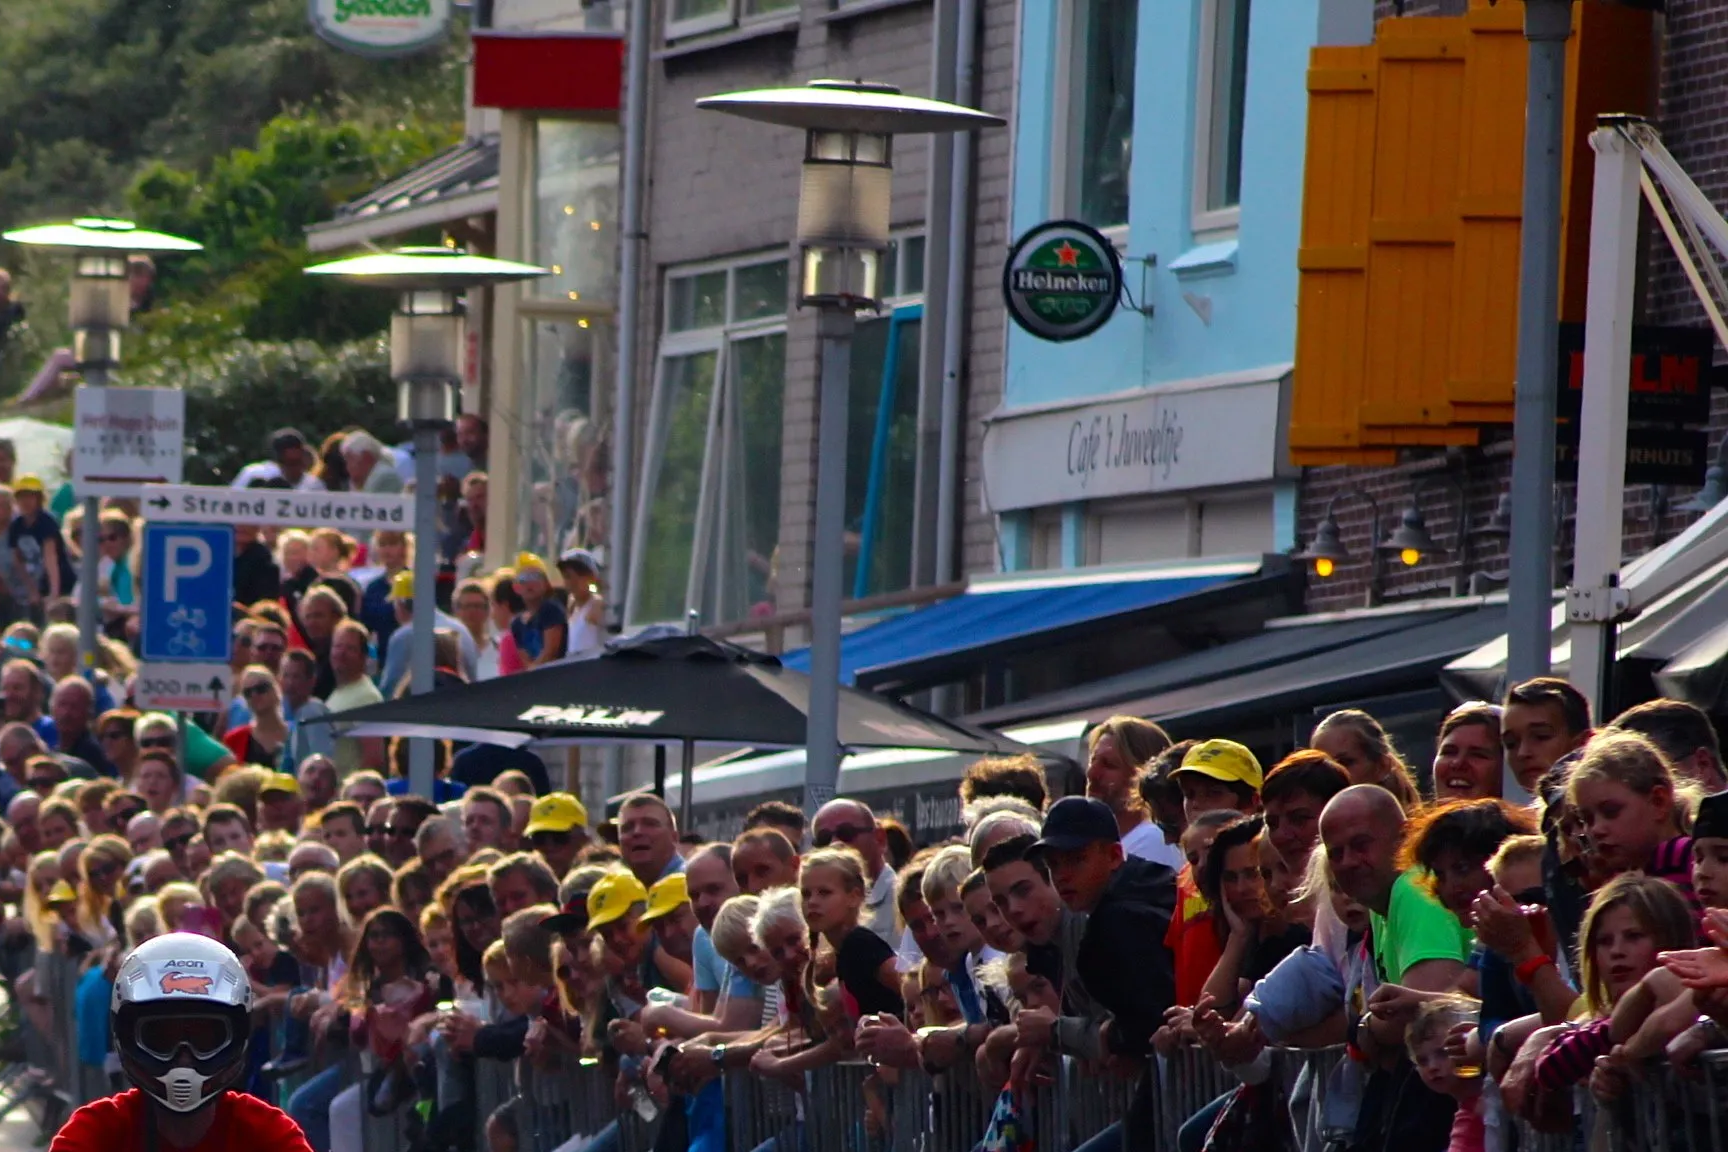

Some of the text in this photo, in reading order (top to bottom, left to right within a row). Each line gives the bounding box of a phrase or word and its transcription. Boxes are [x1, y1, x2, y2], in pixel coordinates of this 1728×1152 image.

[1018, 271, 1109, 293] Heineken
[1067, 415, 1101, 488] Café
[1114, 408, 1184, 481] Juweeltje
[183, 495, 404, 523] Strand Zuiderbad
[163, 535, 213, 603] P
[186, 683, 202, 695] m
[517, 704, 665, 727] PALM
[915, 793, 964, 830] Restauran
